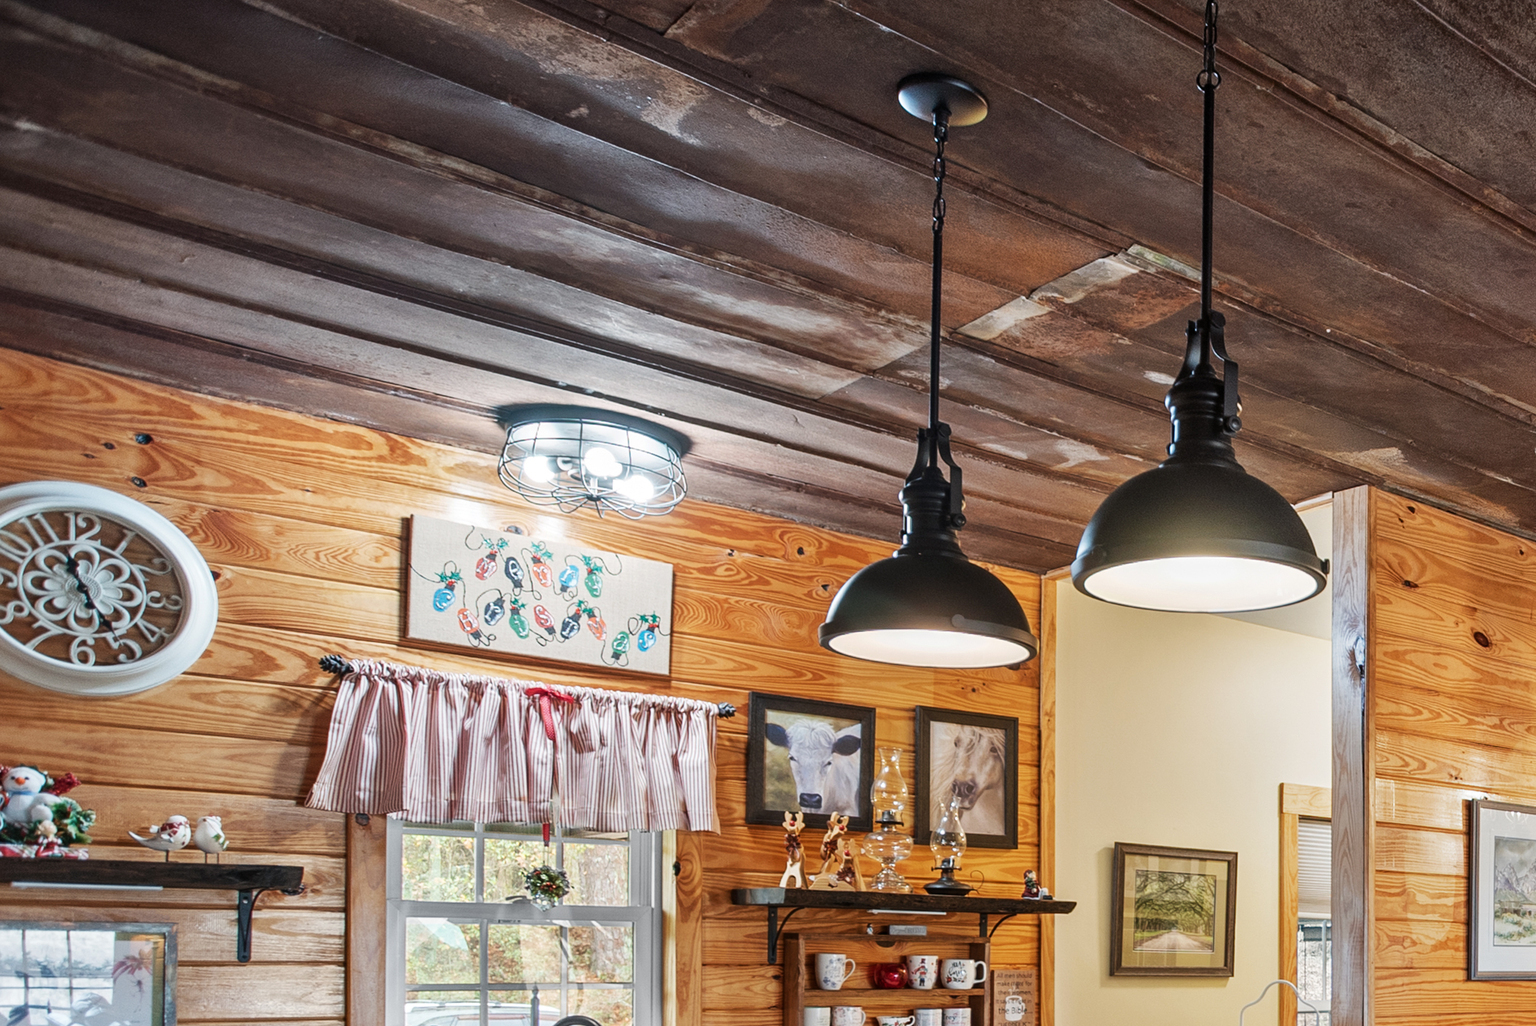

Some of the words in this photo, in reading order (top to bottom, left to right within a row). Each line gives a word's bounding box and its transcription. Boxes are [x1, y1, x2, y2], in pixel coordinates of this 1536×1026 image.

[19, 512, 60, 547] 11
[64, 512, 101, 546] 12
[114, 529, 138, 555] 1
[132, 558, 172, 582] 2
[146, 590, 183, 610] 3
[137, 618, 171, 642] 4
[69, 636, 96, 667] 6
[106, 629, 142, 663] 5
